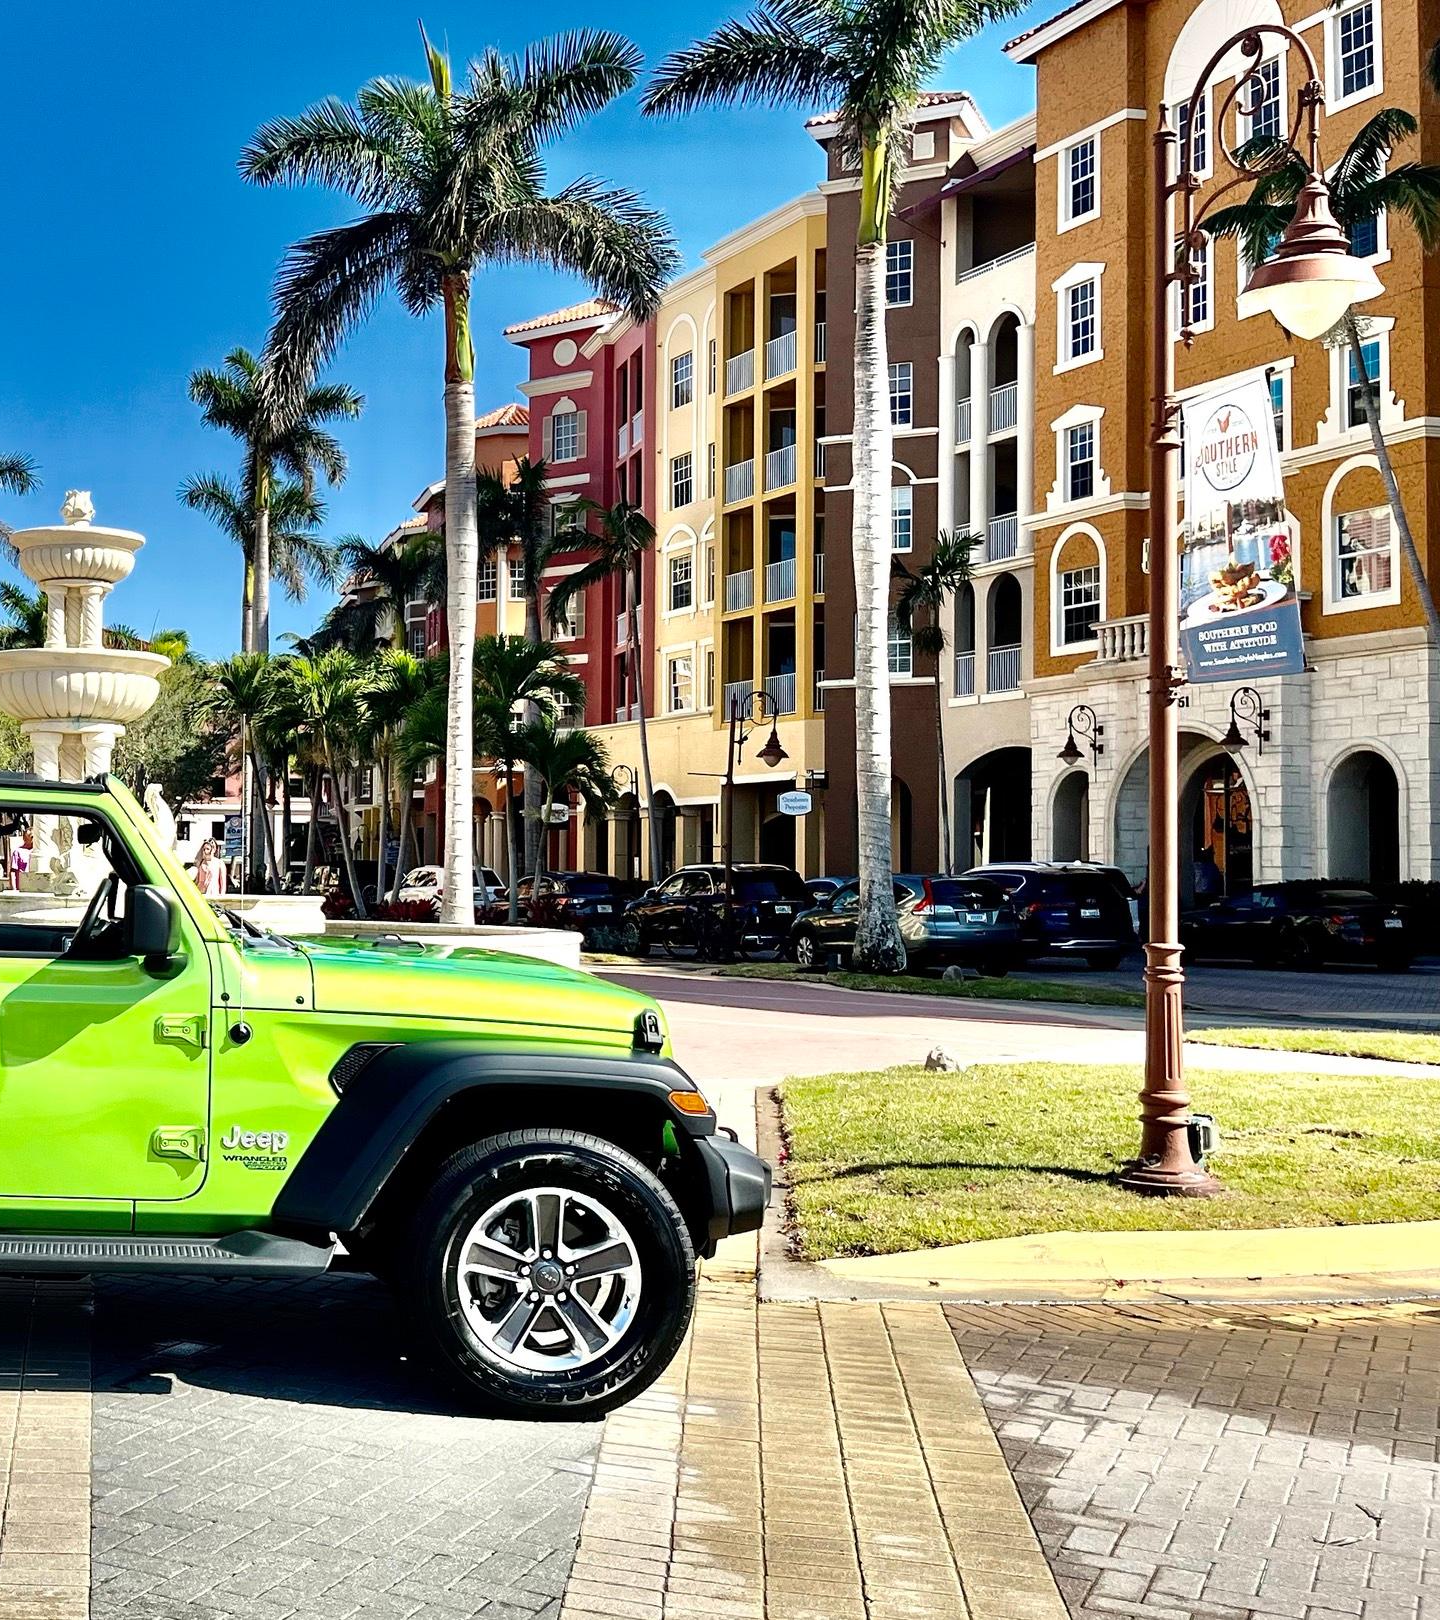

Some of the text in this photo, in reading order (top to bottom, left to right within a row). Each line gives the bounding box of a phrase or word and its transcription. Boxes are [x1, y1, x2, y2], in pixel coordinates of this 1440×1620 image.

[1216, 457, 1238, 477] STYLE
[1198, 621, 1278, 642] SOUTHERN FOOD
[1203, 635, 1277, 653] WITH ATTITUDE
[220, 1125, 288, 1154] Jeep
[223, 1154, 287, 1162] WRANGLER
